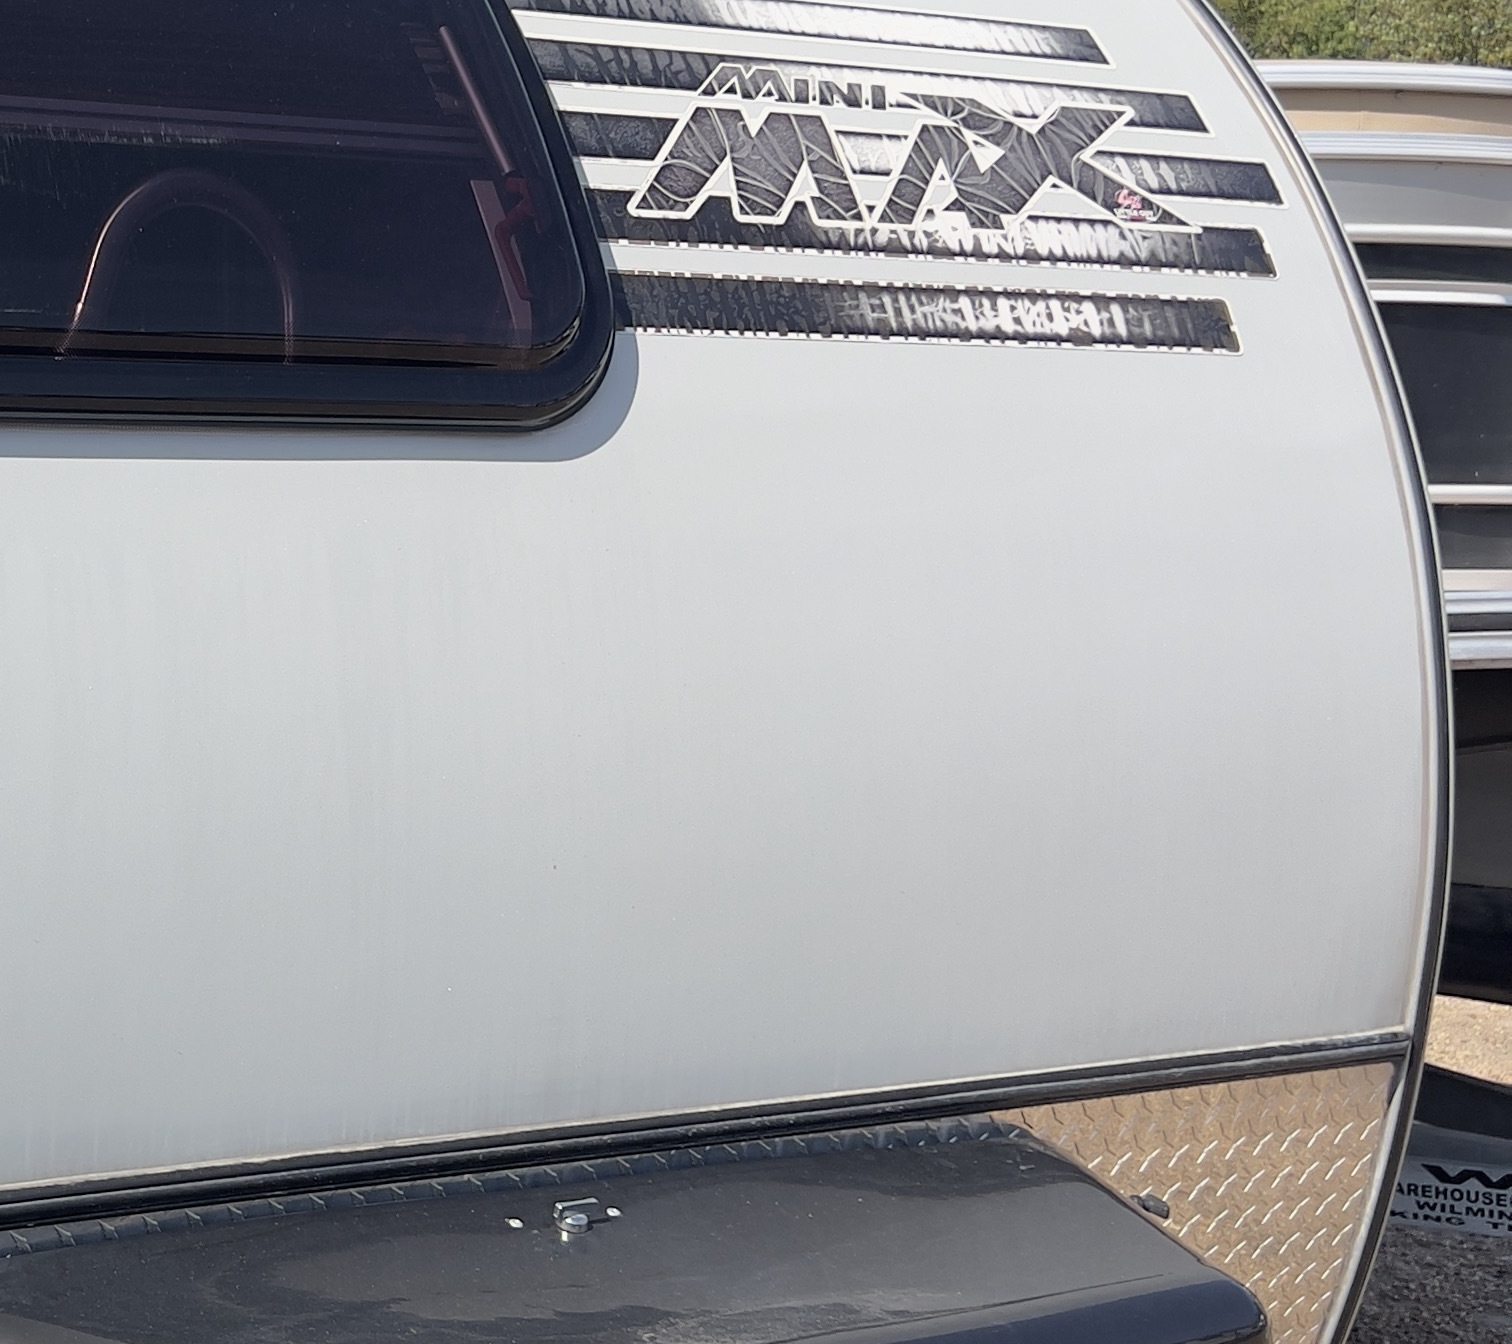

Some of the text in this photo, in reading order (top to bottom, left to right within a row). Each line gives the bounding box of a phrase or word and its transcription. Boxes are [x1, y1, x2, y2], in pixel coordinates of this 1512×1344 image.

[697, 62, 890, 112] MINI
[627, 91, 1202, 233] MAX
[1396, 1182, 1512, 1208] AREHOUSE
